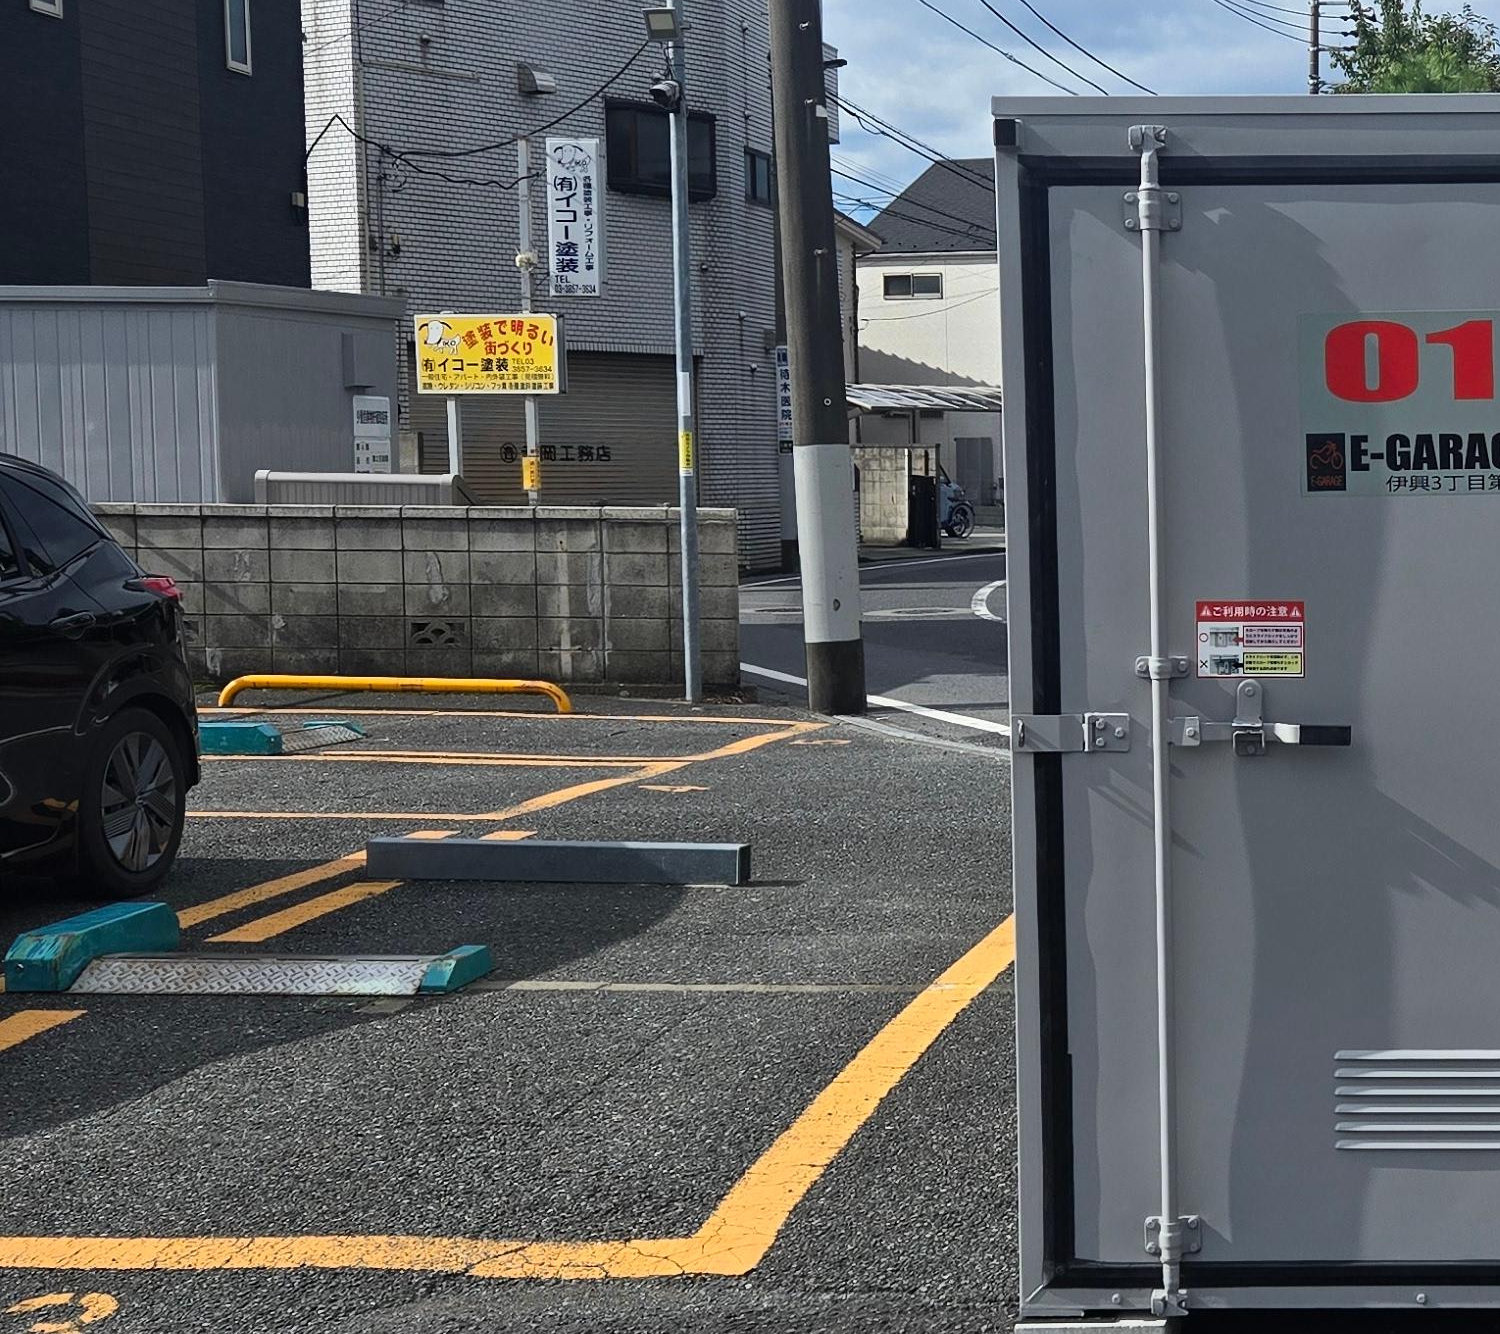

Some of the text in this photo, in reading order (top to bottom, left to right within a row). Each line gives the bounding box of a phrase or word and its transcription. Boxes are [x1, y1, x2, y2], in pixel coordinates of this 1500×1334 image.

[554, 275, 571, 284] TEL
[462, 319, 554, 350] 塗装で明るい
[484, 341, 533, 356] 街づくり
[1324, 319, 1495, 404] 01
[520, 444, 612, 463] 岡工務店
[1212, 605, 1289, 618] ご利用時の注意
